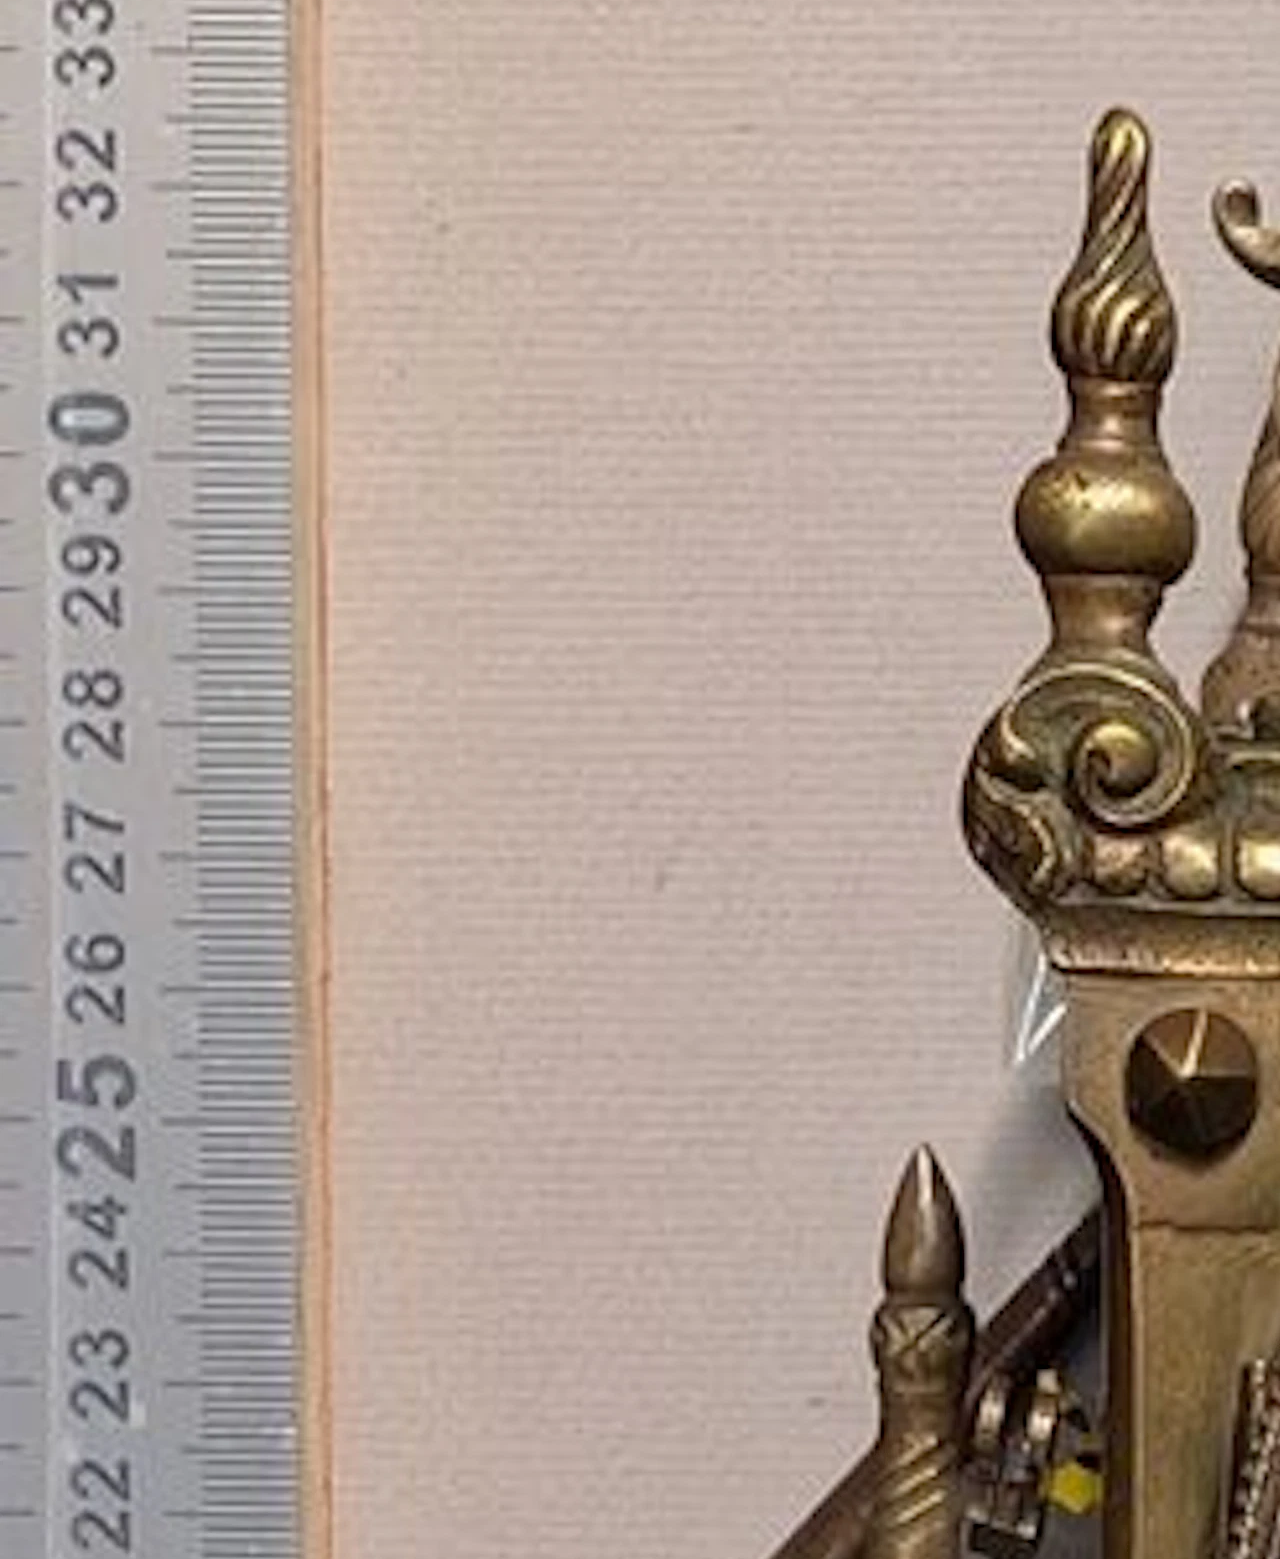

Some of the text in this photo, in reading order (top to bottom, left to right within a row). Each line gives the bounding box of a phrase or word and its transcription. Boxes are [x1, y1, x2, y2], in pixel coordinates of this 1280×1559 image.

[55, 129, 118, 223] 32
[56, 274, 119, 359] 31
[48, 392, 130, 515] 30
[61, 535, 122, 629] 29
[62, 669, 124, 762] 28
[64, 802, 125, 894] 27
[64, 934, 125, 1025] 26
[56, 1055, 136, 1182] 25
[67, 1196, 129, 1290] 24
[69, 1329, 130, 1422] 23
[70, 1460, 131, 1553] 22
